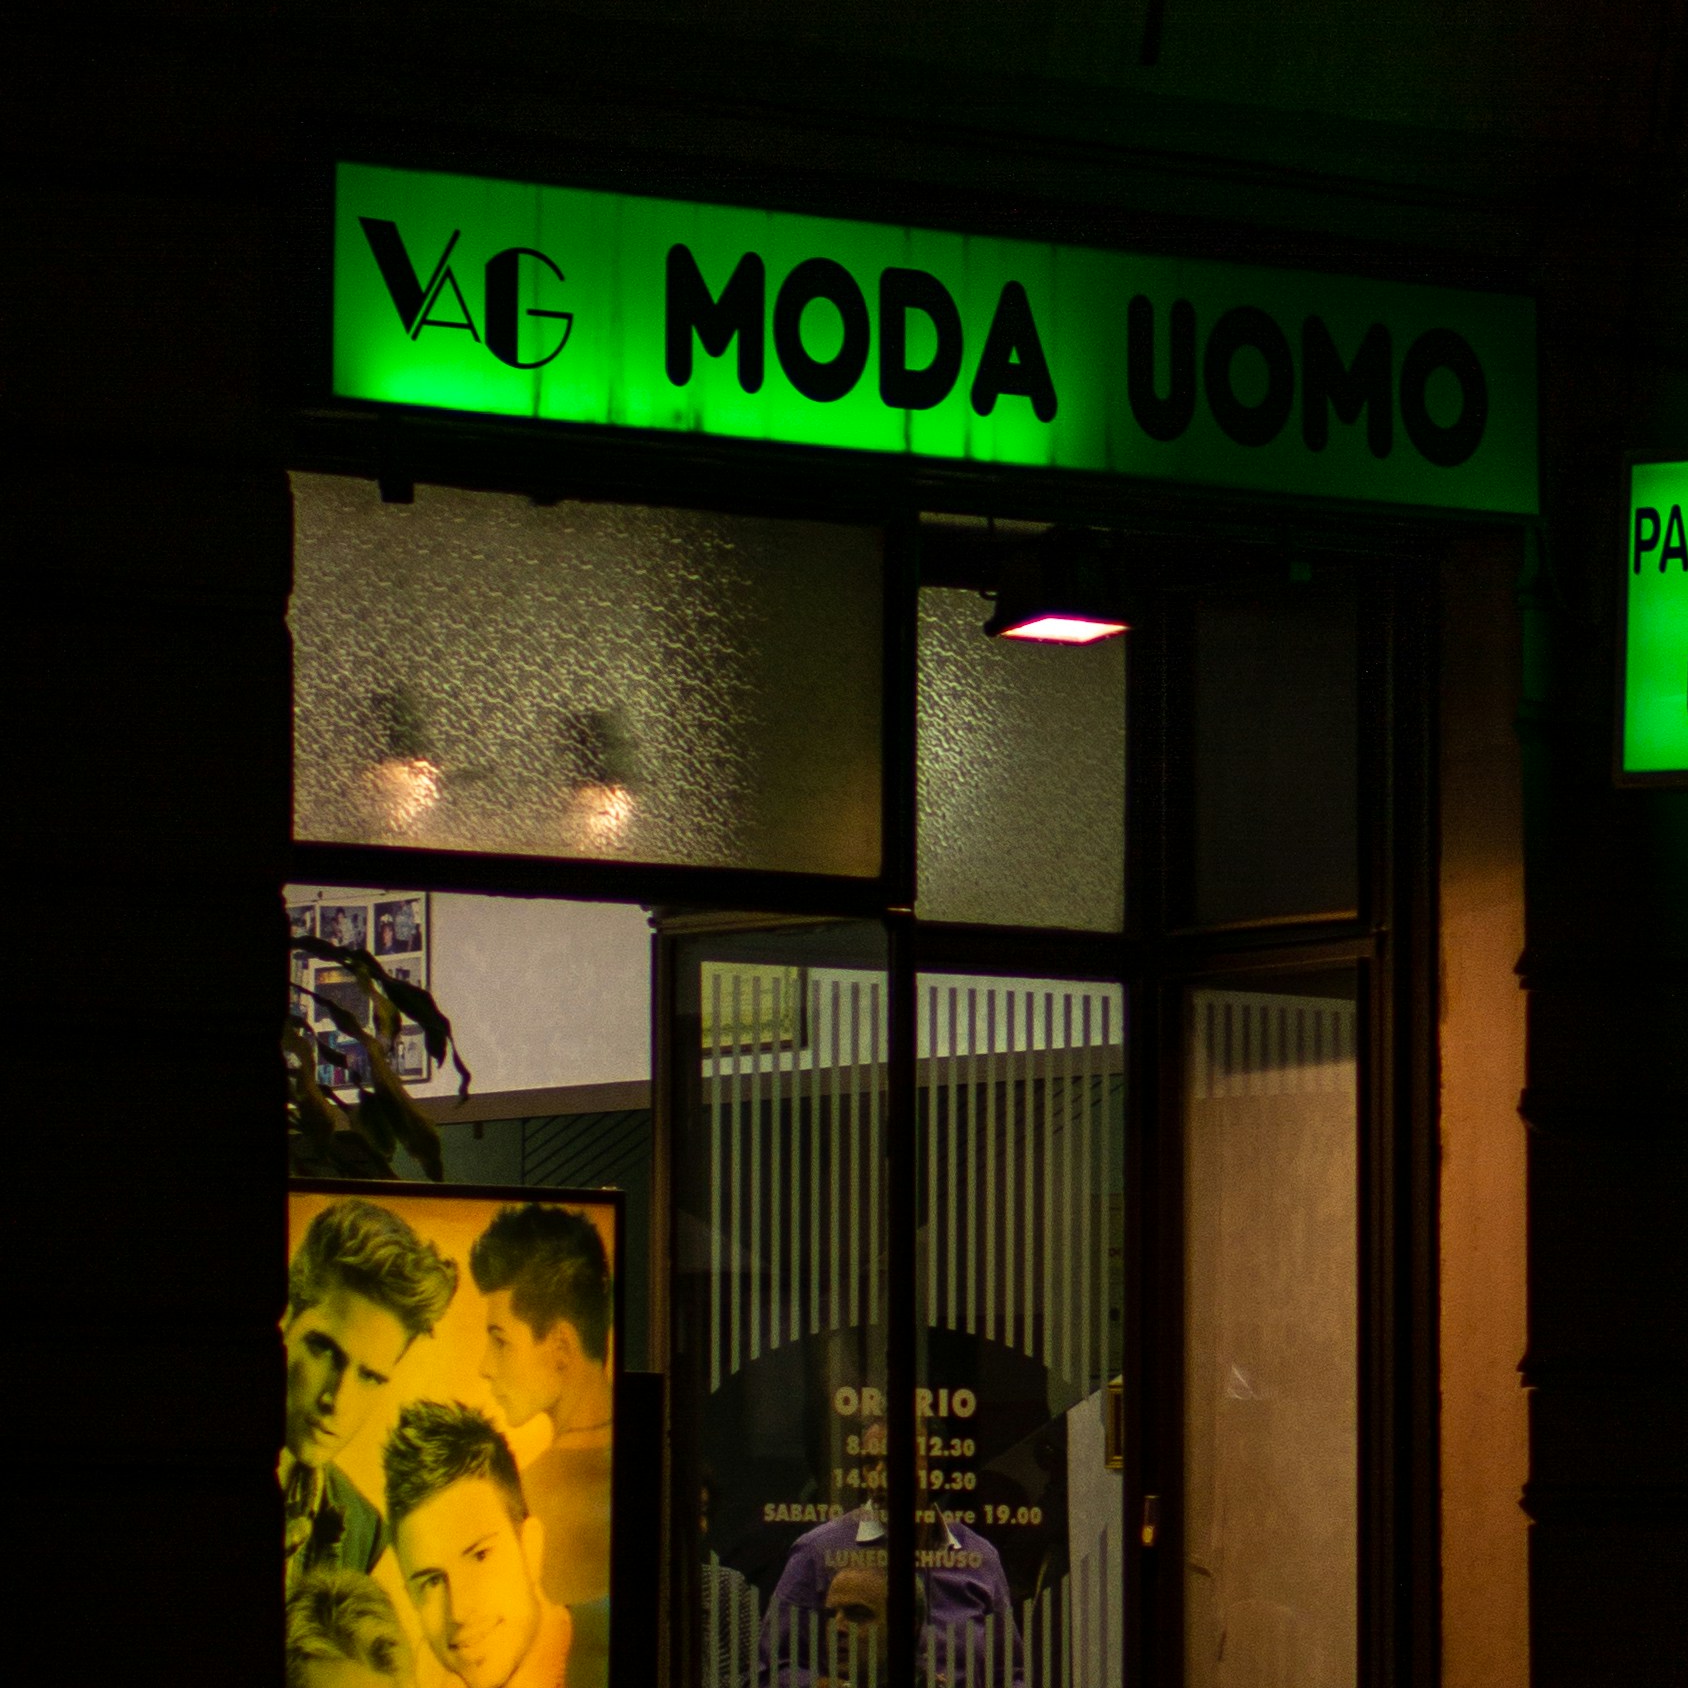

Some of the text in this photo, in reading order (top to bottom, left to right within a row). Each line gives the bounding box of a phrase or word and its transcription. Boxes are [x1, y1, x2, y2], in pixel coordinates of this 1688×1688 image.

[665, 242, 1058, 423] MODA
[1129, 293, 1488, 468] UOMO
[832, 1385, 978, 1419] ORRIO
[917, 1435, 977, 1458] 12.30
[917, 1469, 978, 1491] 19.30
[763, 1502, 844, 1525] SABATO
[942, 1508, 976, 1525] ore
[984, 1504, 1043, 1525] 19.00
[825, 1549, 983, 1569] LUNED HIUSO
